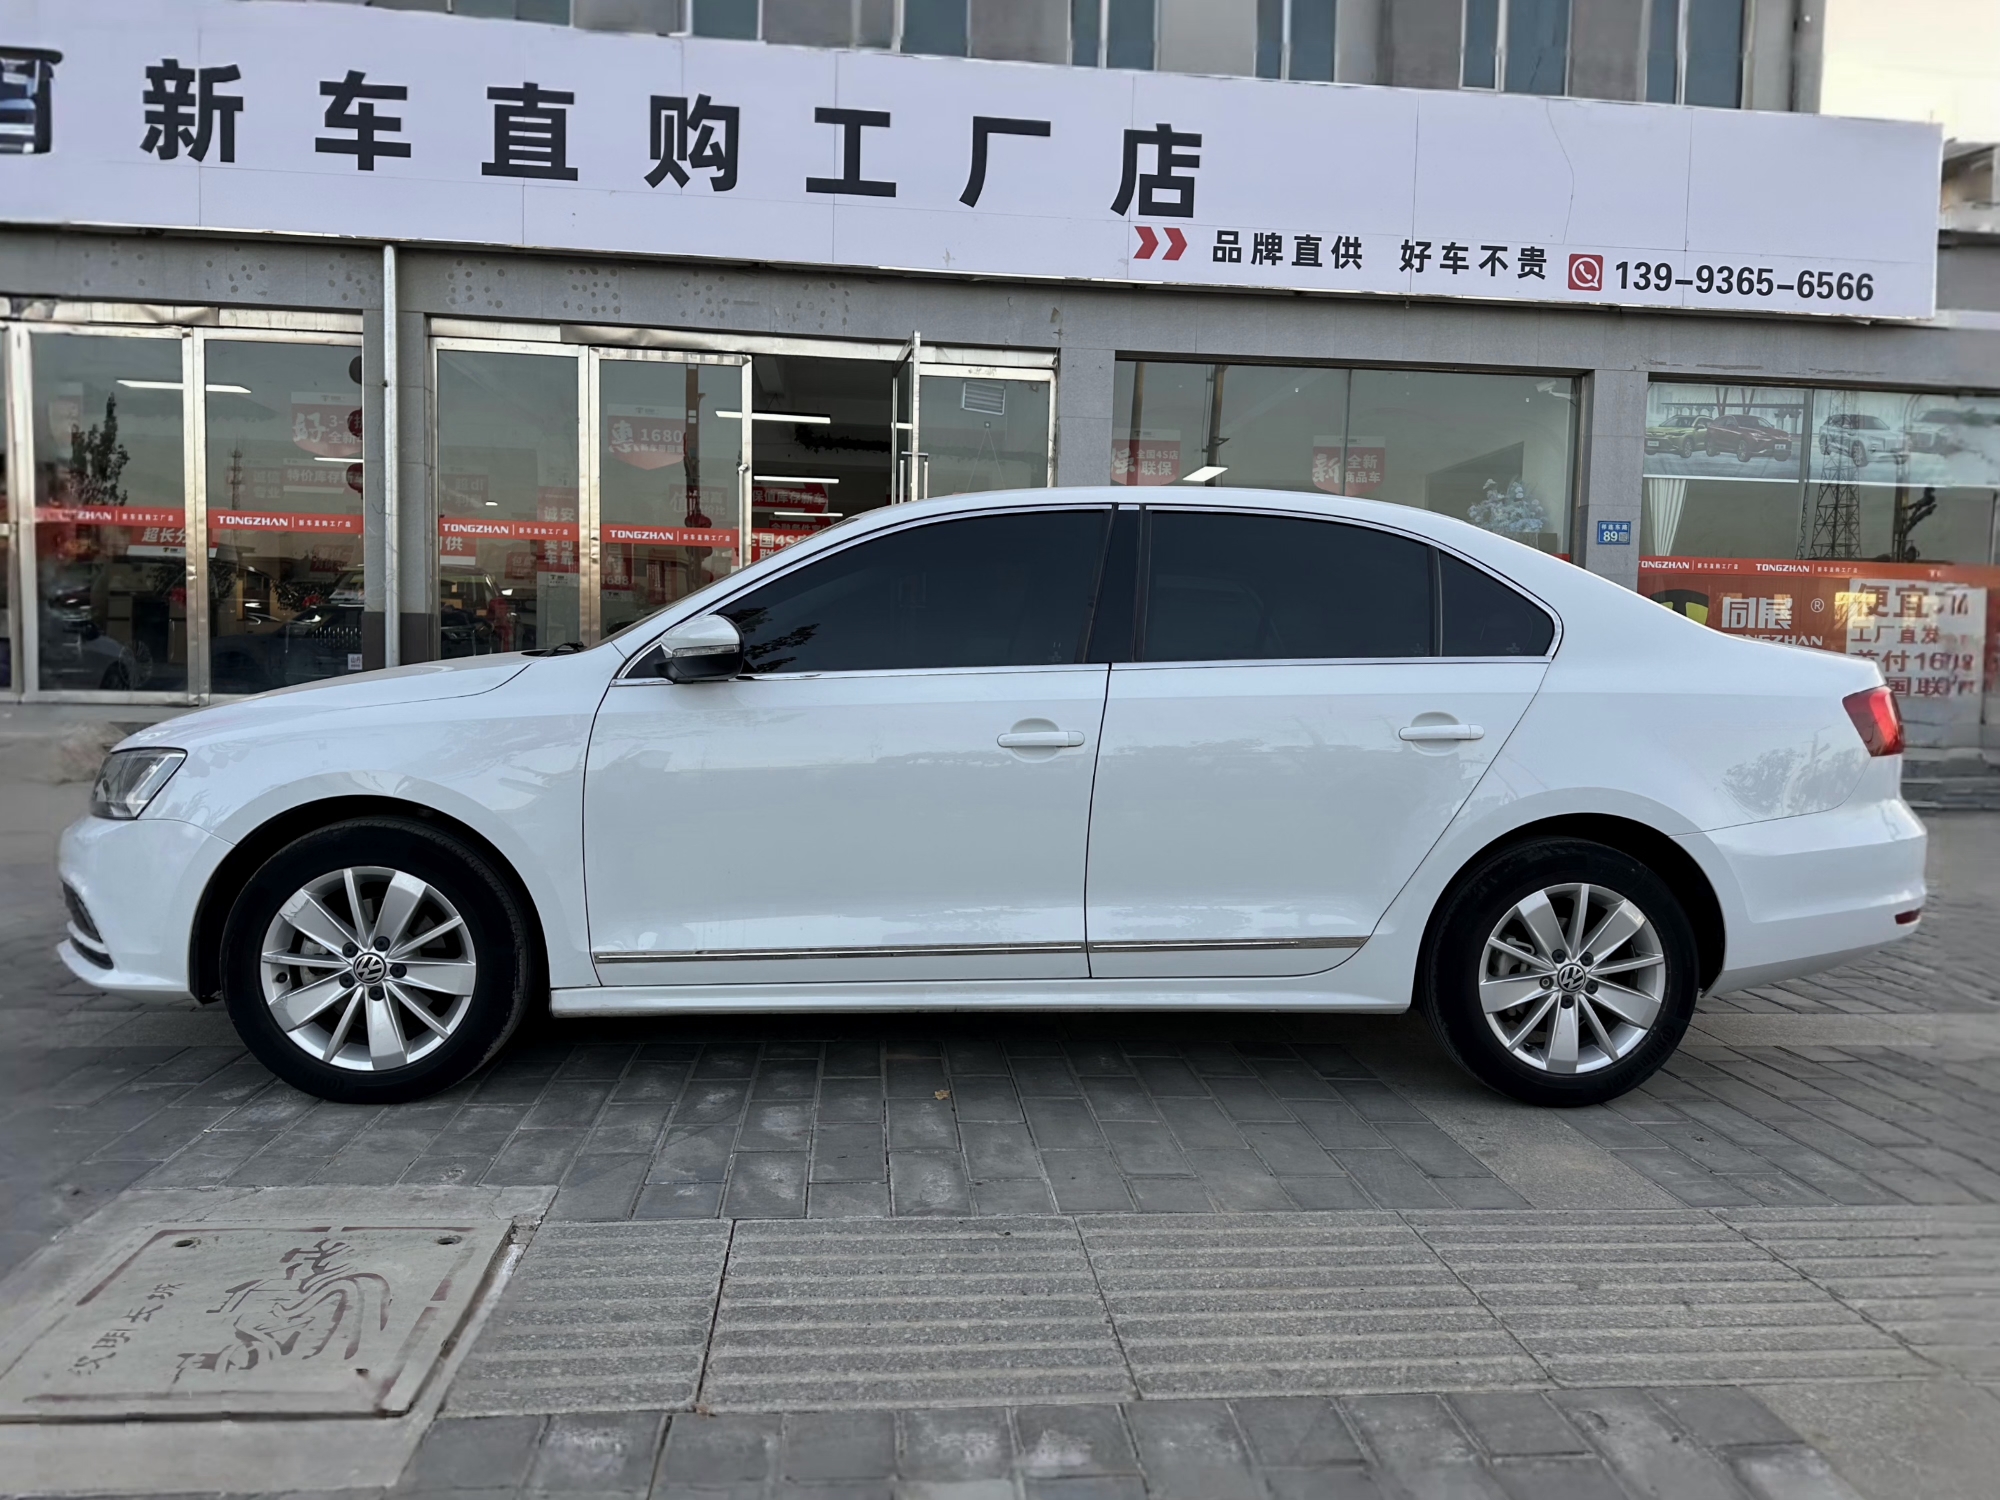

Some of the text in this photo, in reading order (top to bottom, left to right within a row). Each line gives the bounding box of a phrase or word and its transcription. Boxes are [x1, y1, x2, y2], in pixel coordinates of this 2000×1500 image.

[139, 58, 1202, 218] 新车直购工厂店
[1211, 230, 1875, 302] 品牌直供 好车不贵 139-9365-6566
[640, 428, 683, 443] 1680
[1138, 449, 1179, 460] 全国4S店
[1347, 454, 1378, 469] 全新
[1141, 461, 1173, 476] 联保
[217, 515, 288, 527] TONGZHAN
[442, 523, 509, 534] TONGZHAN
[609, 529, 674, 541] TONGZHAN
[1603, 530, 1618, 542] 89
[1756, 563, 1810, 573] TONGZHAN
